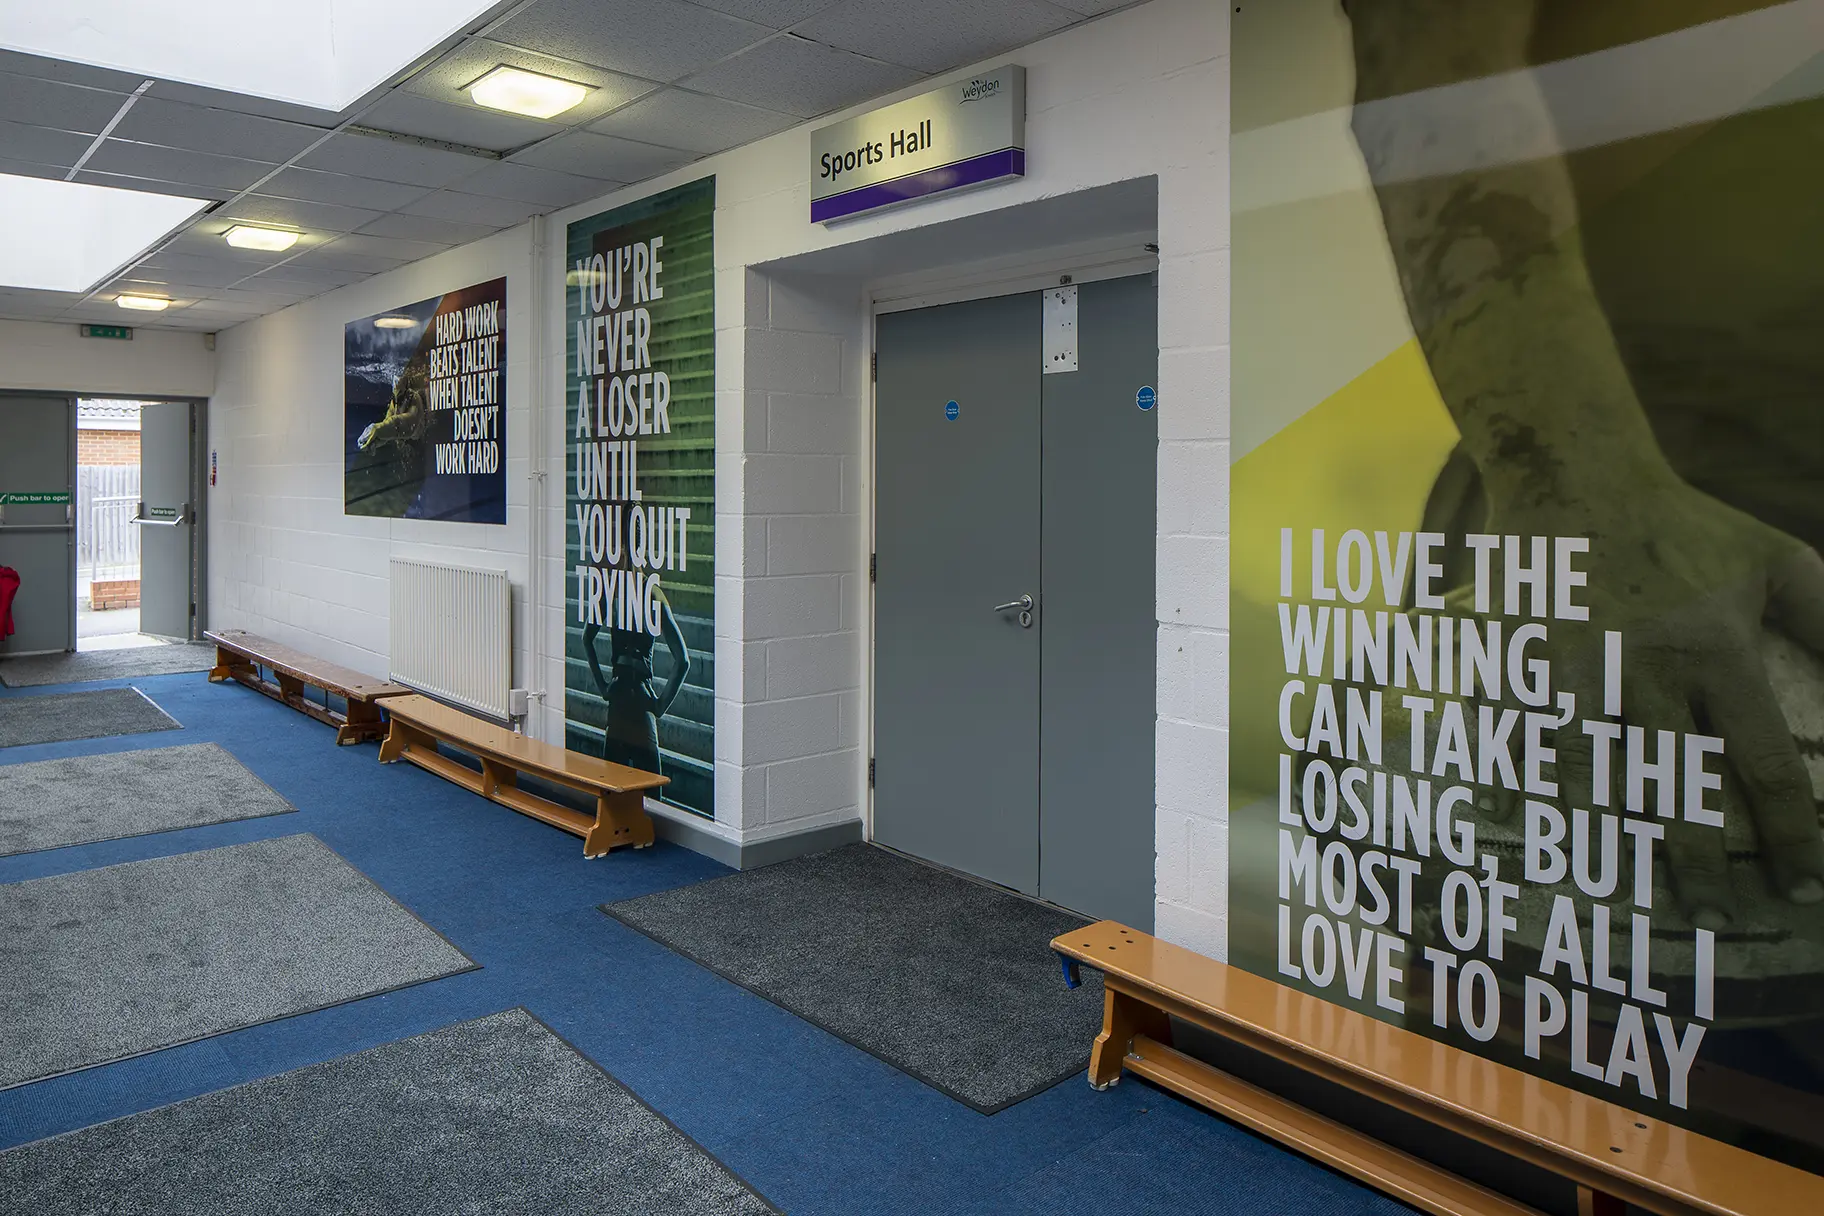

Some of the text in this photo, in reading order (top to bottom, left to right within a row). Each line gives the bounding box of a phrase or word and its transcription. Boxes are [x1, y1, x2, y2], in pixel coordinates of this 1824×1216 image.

[962, 79, 999, 99] Weydon
[820, 119, 931, 181] Sports Hall
[576, 235, 664, 315] YOU'RE
[436, 300, 499, 346] HARD WORK
[577, 308, 651, 377] NEVER
[430, 336, 499, 379] BEATS TALENT
[430, 370, 499, 411] WHEN TALENT
[454, 405, 499, 441] DOESN'T
[575, 372, 670, 439] A LOSER
[436, 441, 499, 475] WORK HARD
[577, 440, 642, 501] UNTIL
[576, 504, 691, 572] YOU QUIT
[576, 565, 662, 637] TRYING
[1280, 528, 1589, 621] I LOVE THE
[1278, 603, 1622, 724] WINNING, I
[1278, 680, 1725, 828] CAN TAKE THE
[1279, 754, 1664, 909] LOSING, BUT
[1279, 829, 1715, 1021] MOST OF ALL I
[1279, 904, 1707, 1110] LOVE TO PLAY
